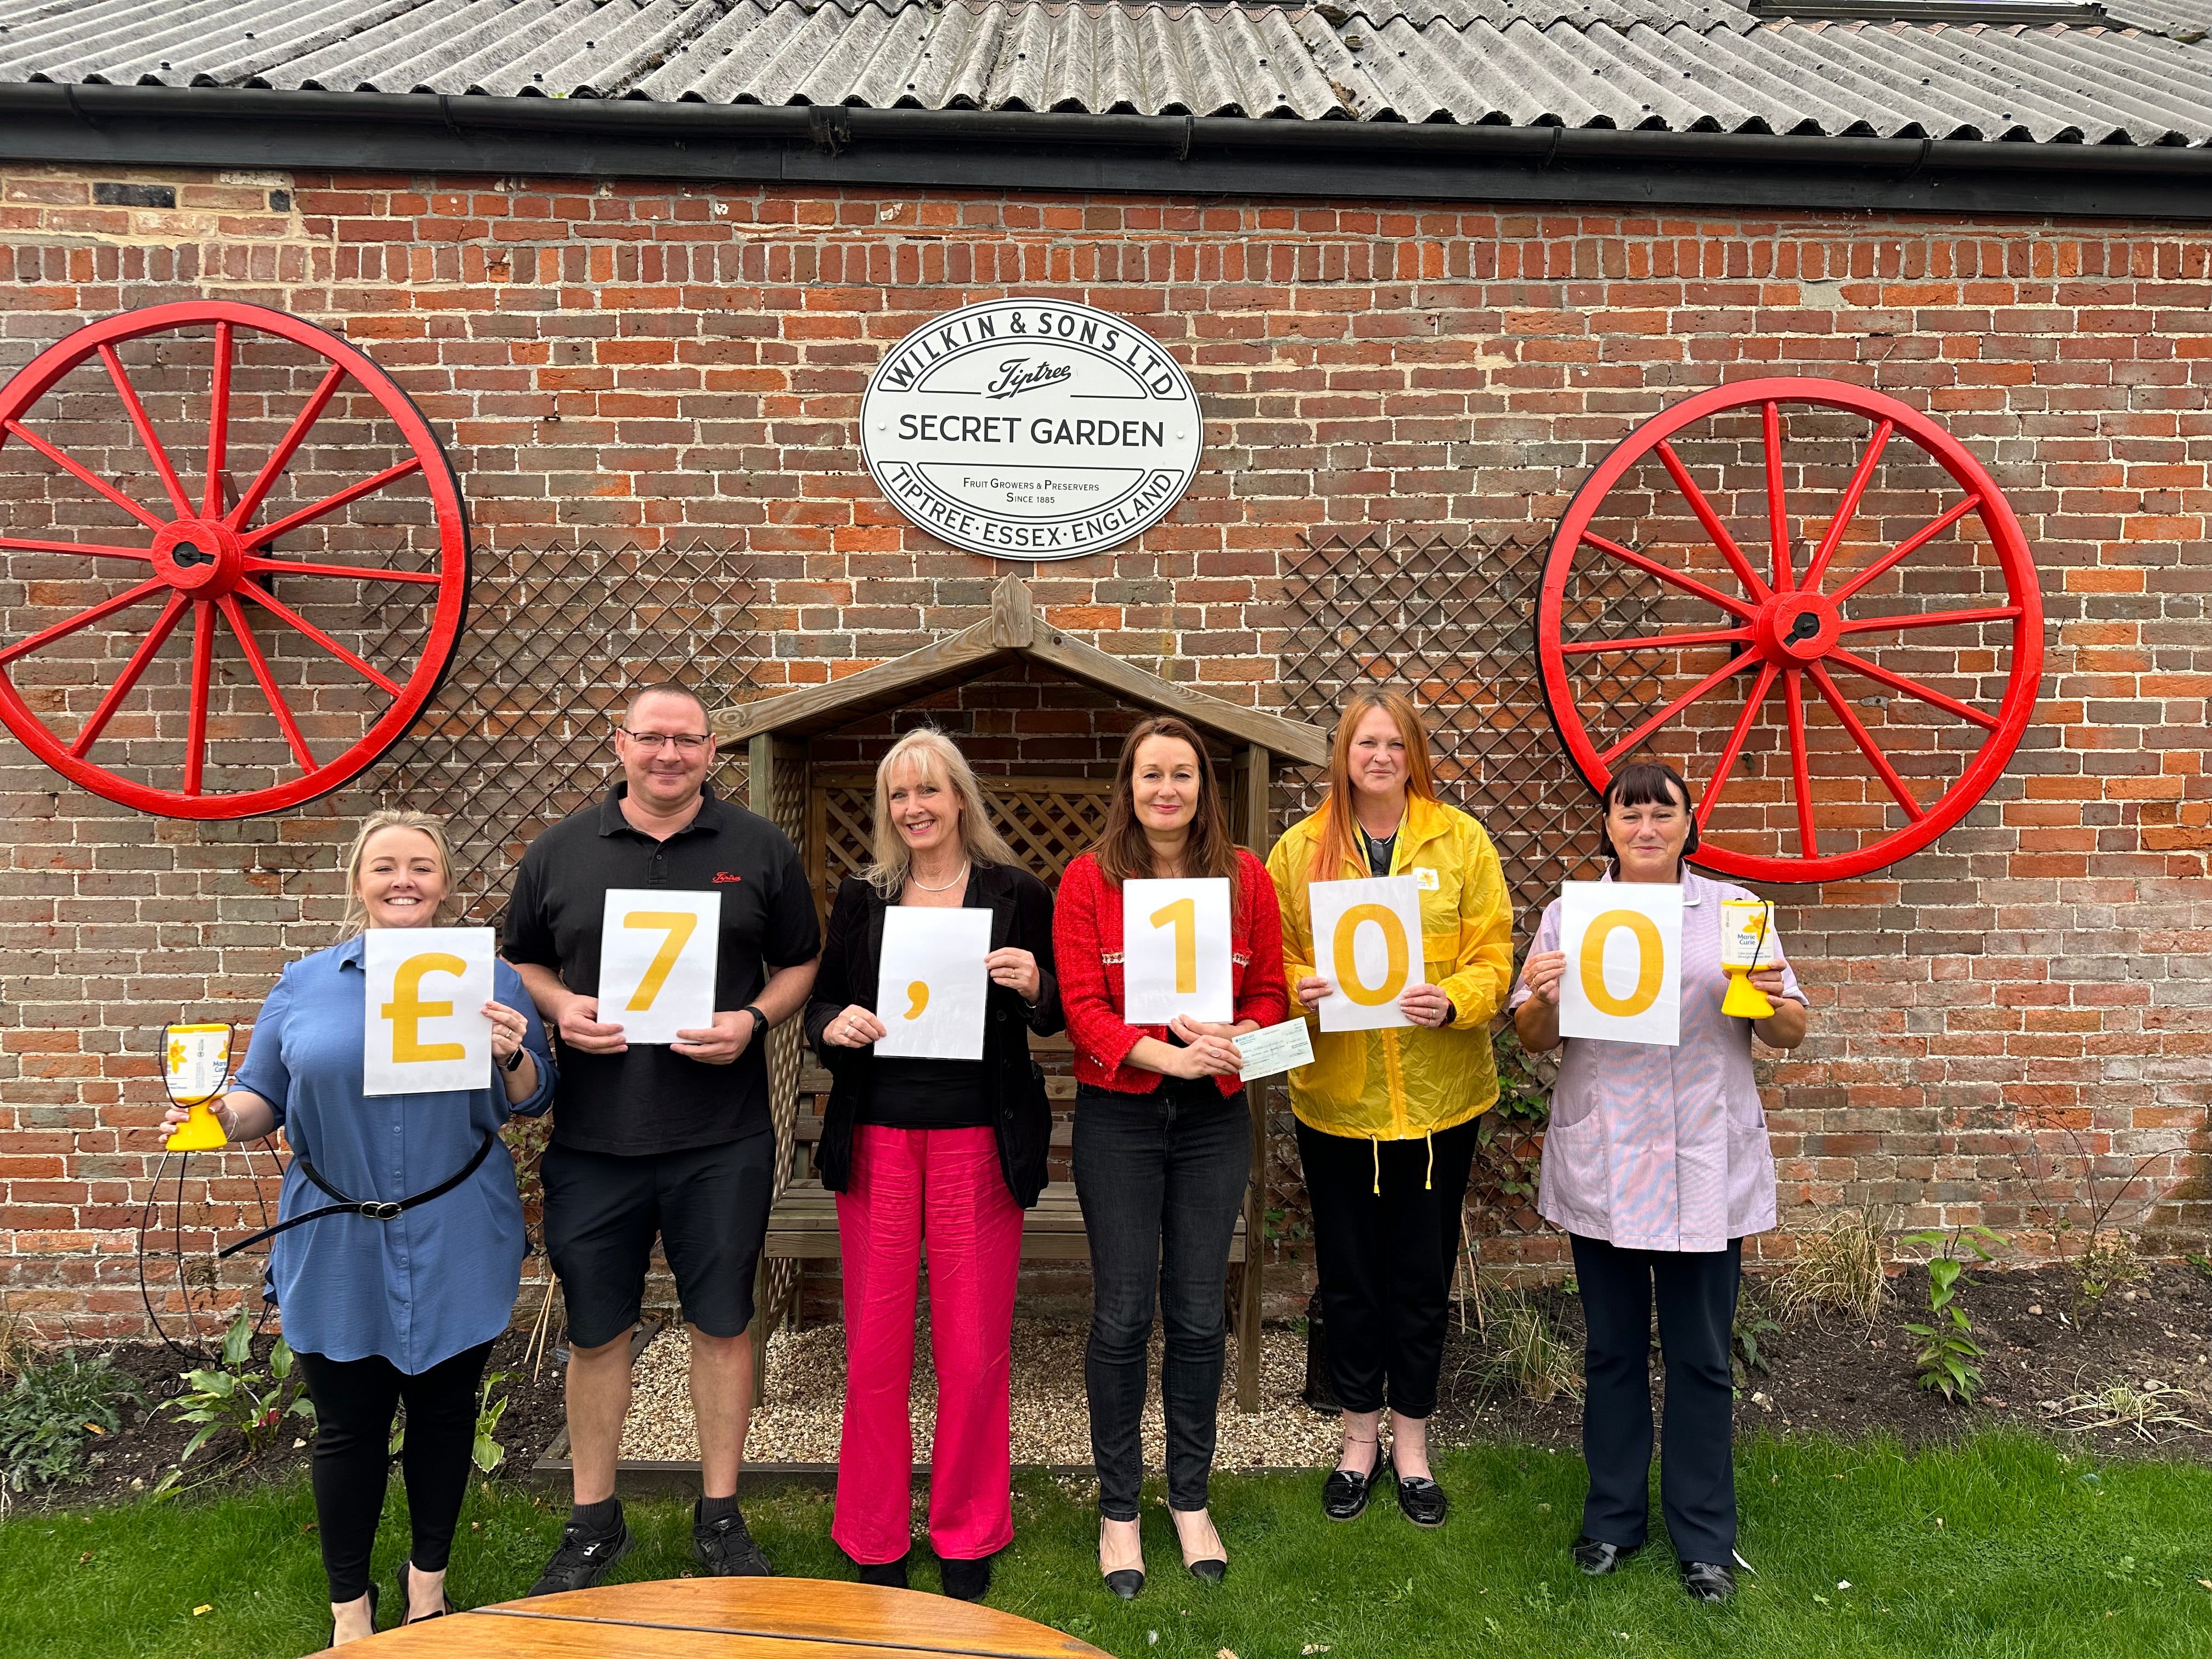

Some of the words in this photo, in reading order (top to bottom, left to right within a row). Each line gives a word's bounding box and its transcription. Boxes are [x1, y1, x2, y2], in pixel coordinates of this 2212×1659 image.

[886, 315, 996, 388] WILKIN
[1010, 312, 1027, 334] &
[1038, 312, 1120, 352] SONS
[1126, 343, 1173, 395] LTD
[985, 357, 1071, 399] Tiptree
[899, 414, 1022, 443] SECRET
[1030, 418, 1164, 447] GARDEN
[381, 952, 467, 1063] £
[623, 911, 697, 1011] 7
[1149, 898, 1197, 994] 1
[1333, 903, 1409, 1007] 0
[1579, 909, 1664, 1018] 0
